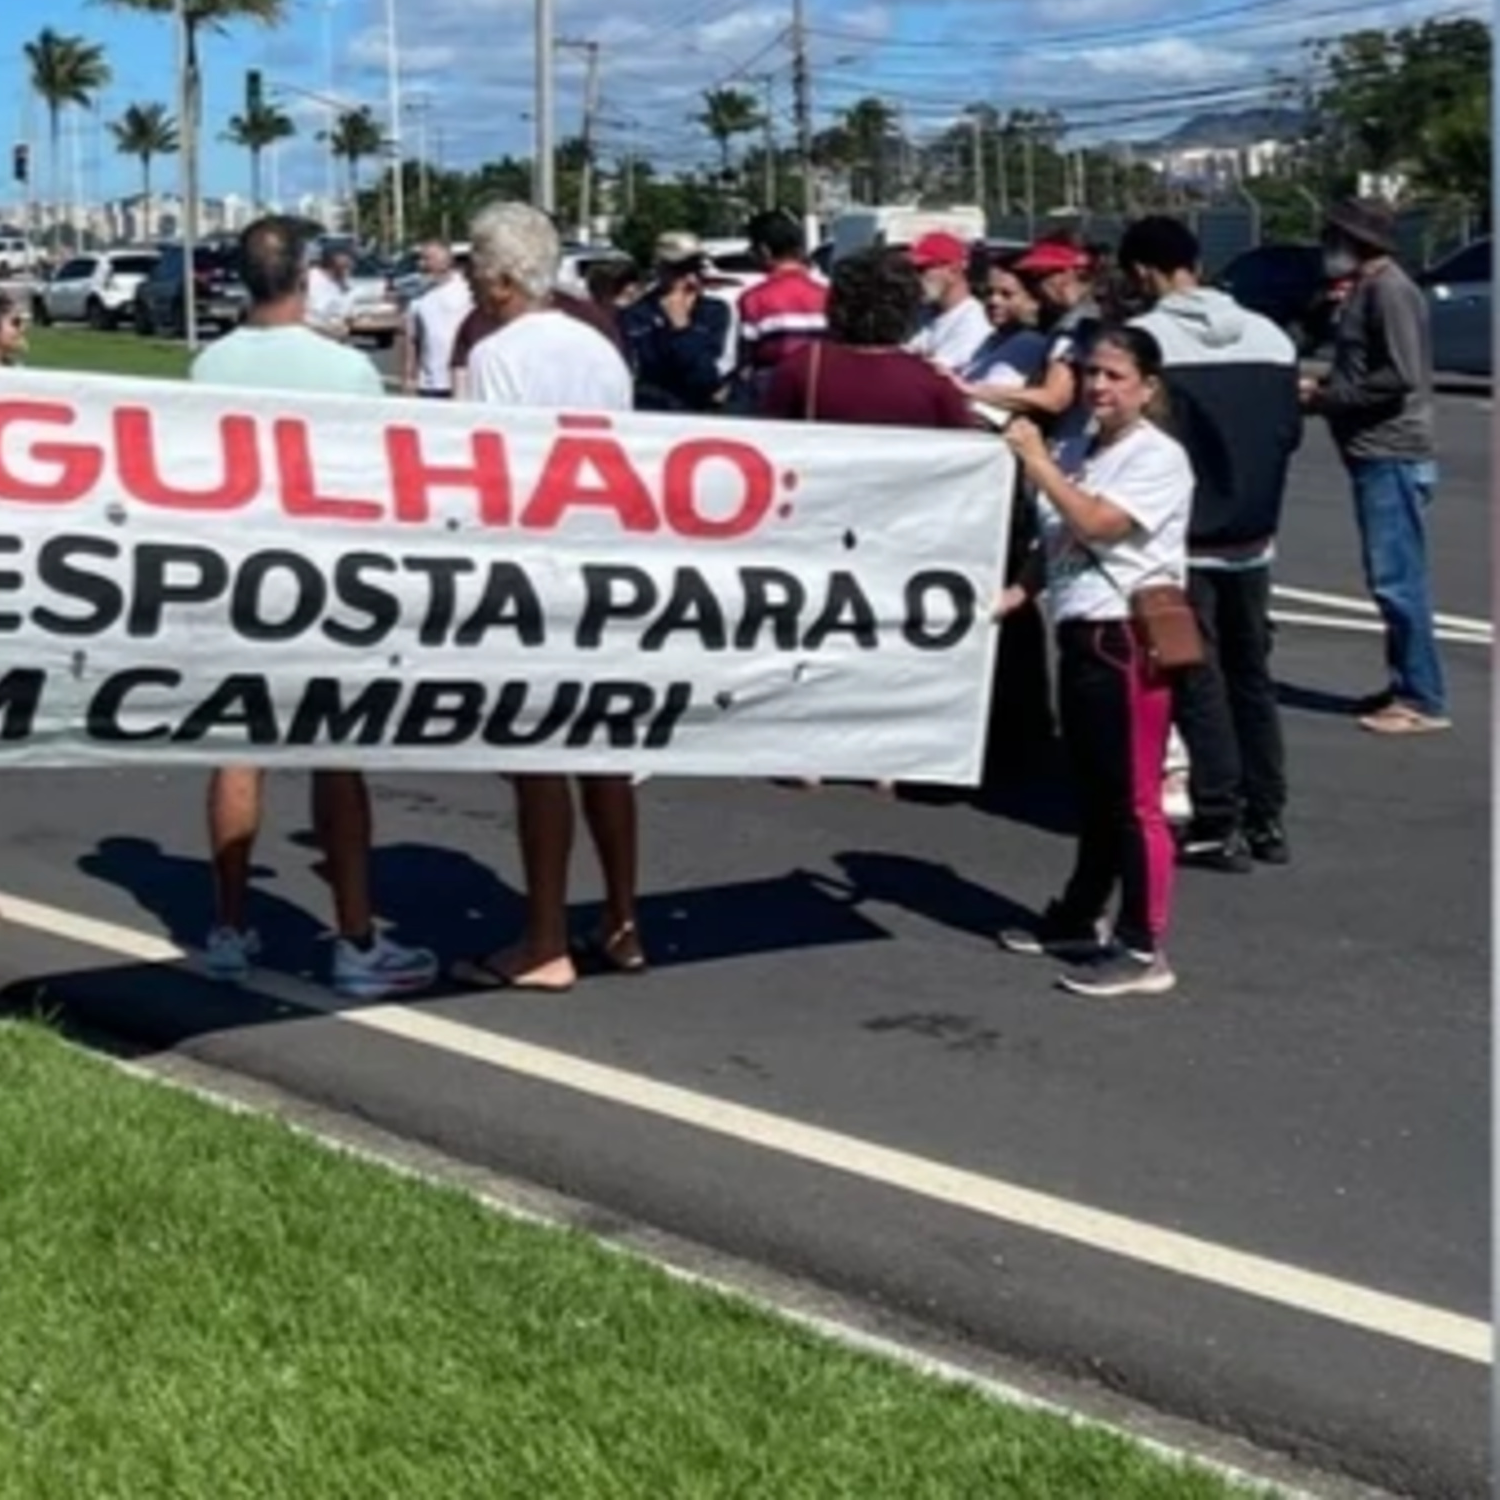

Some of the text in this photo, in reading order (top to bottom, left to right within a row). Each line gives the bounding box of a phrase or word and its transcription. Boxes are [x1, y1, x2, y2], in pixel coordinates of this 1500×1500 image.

[576, 564, 878, 651] PARA
[902, 568, 976, 649] O
[86, 667, 691, 748] CAMBURI
